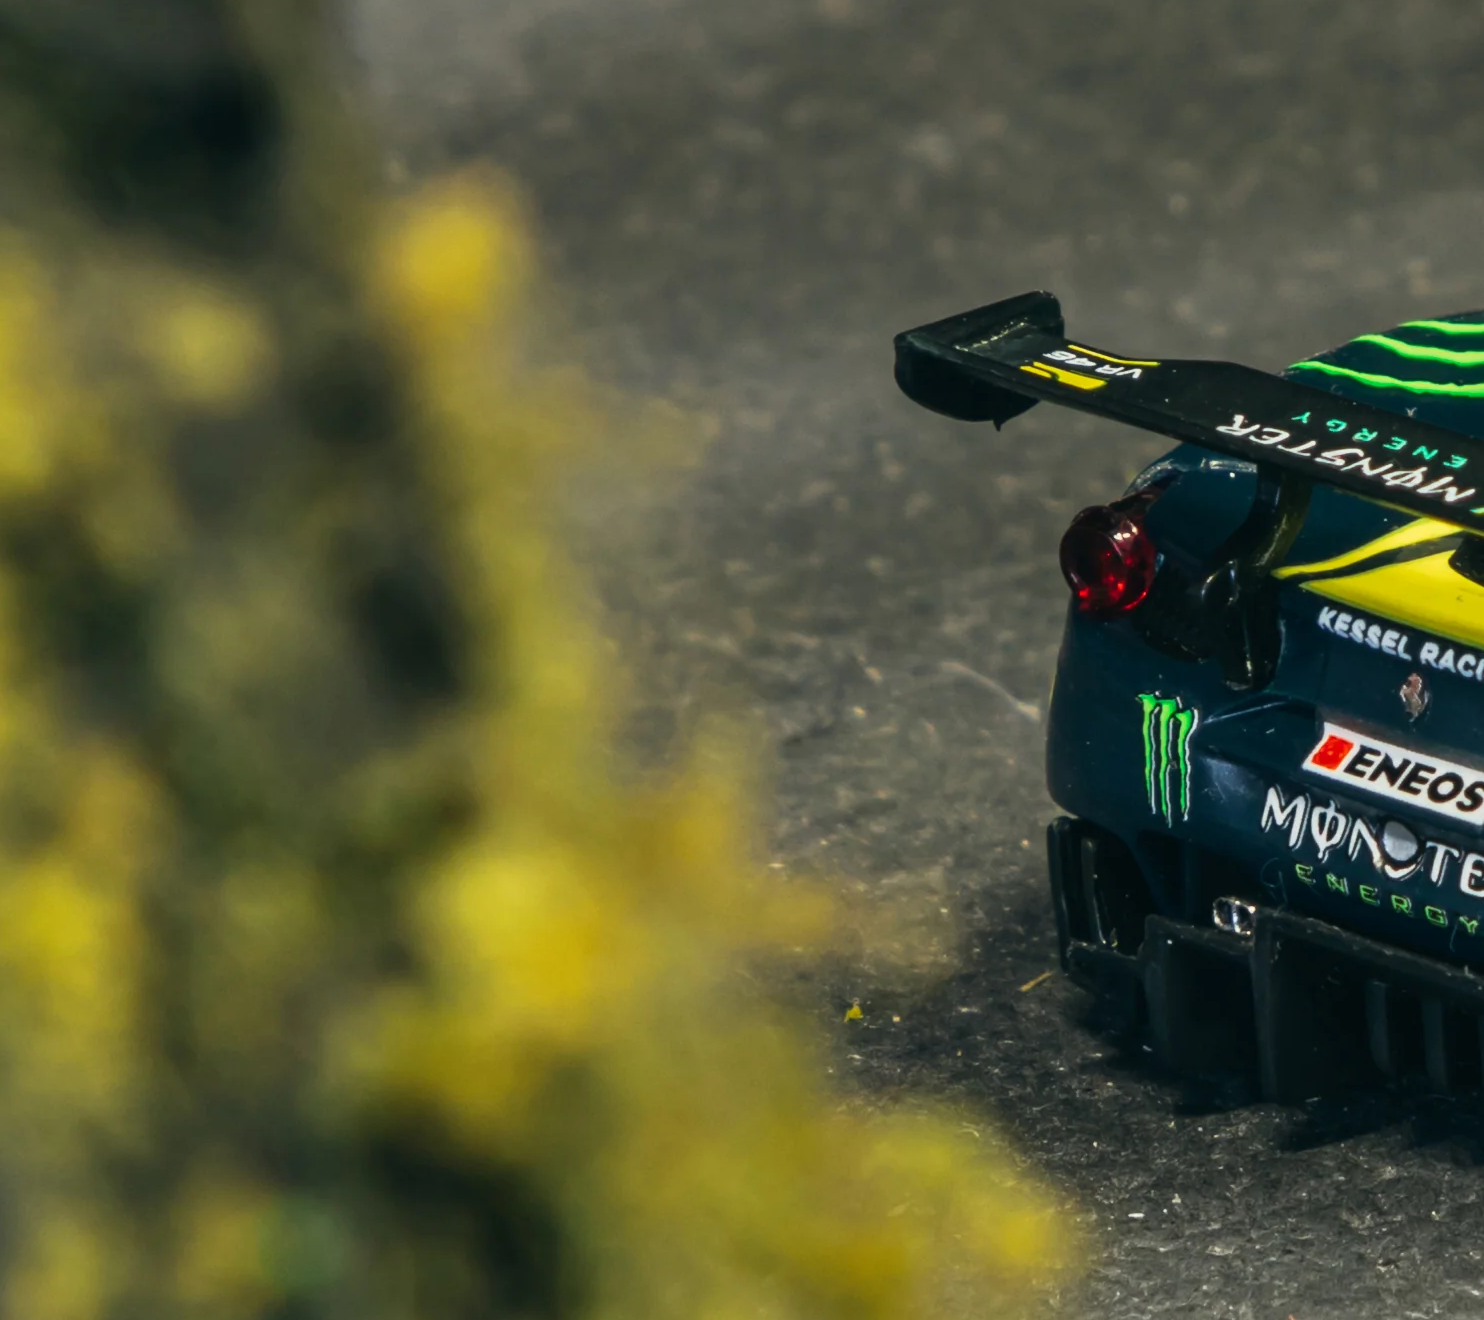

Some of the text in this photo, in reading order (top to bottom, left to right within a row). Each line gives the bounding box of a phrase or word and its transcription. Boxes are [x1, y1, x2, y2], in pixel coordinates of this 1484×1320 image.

[1290, 411, 1469, 470] ENERGY
[1317, 606, 1412, 662] KESSEL
[1295, 863, 1479, 935] ENERGY
